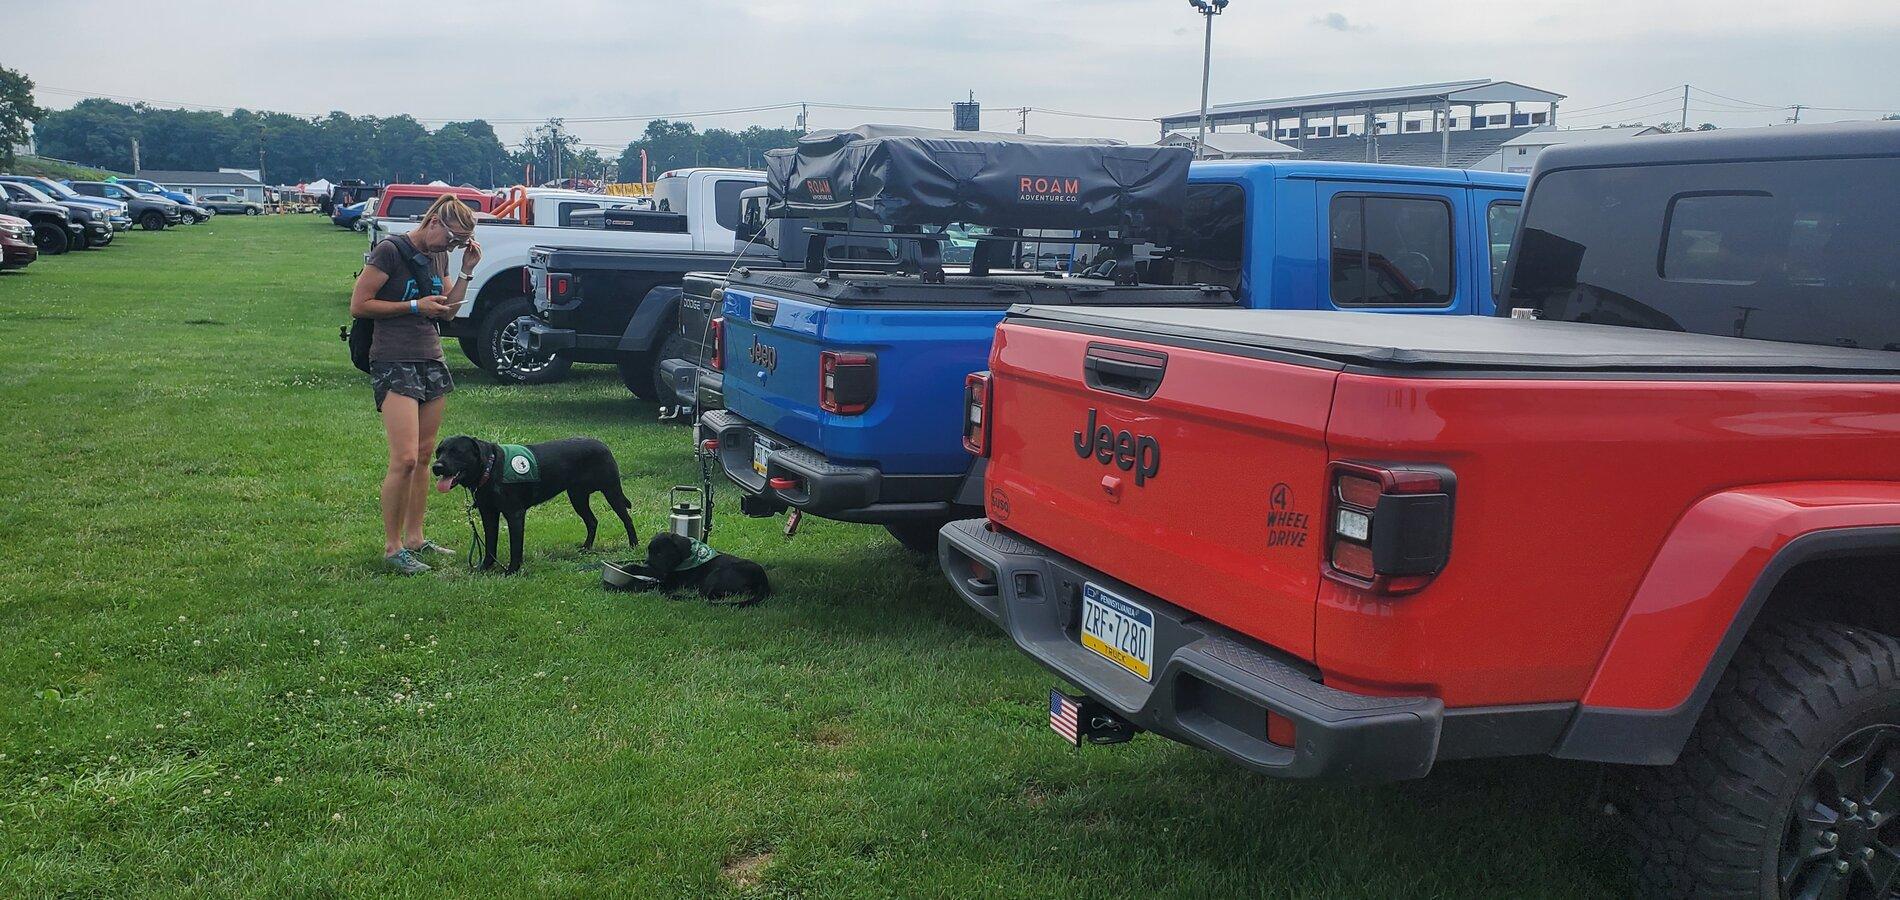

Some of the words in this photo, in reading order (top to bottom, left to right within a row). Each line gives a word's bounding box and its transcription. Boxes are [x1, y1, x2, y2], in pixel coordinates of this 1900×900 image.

[806, 180, 831, 193] ROAM
[1020, 177, 1079, 194] ROAM
[1020, 194, 1064, 202] ADVENTURE
[683, 298, 701, 310] DODGE
[748, 333, 777, 376] Jeep
[1073, 407, 1160, 487] Jeep
[1273, 487, 1287, 510] 4
[1267, 511, 1309, 529] WHEEL
[1267, 530, 1308, 547] DRIVE
[1100, 593, 1135, 617] PENNSYLVANIA
[1104, 644, 1127, 664] TRUCK
